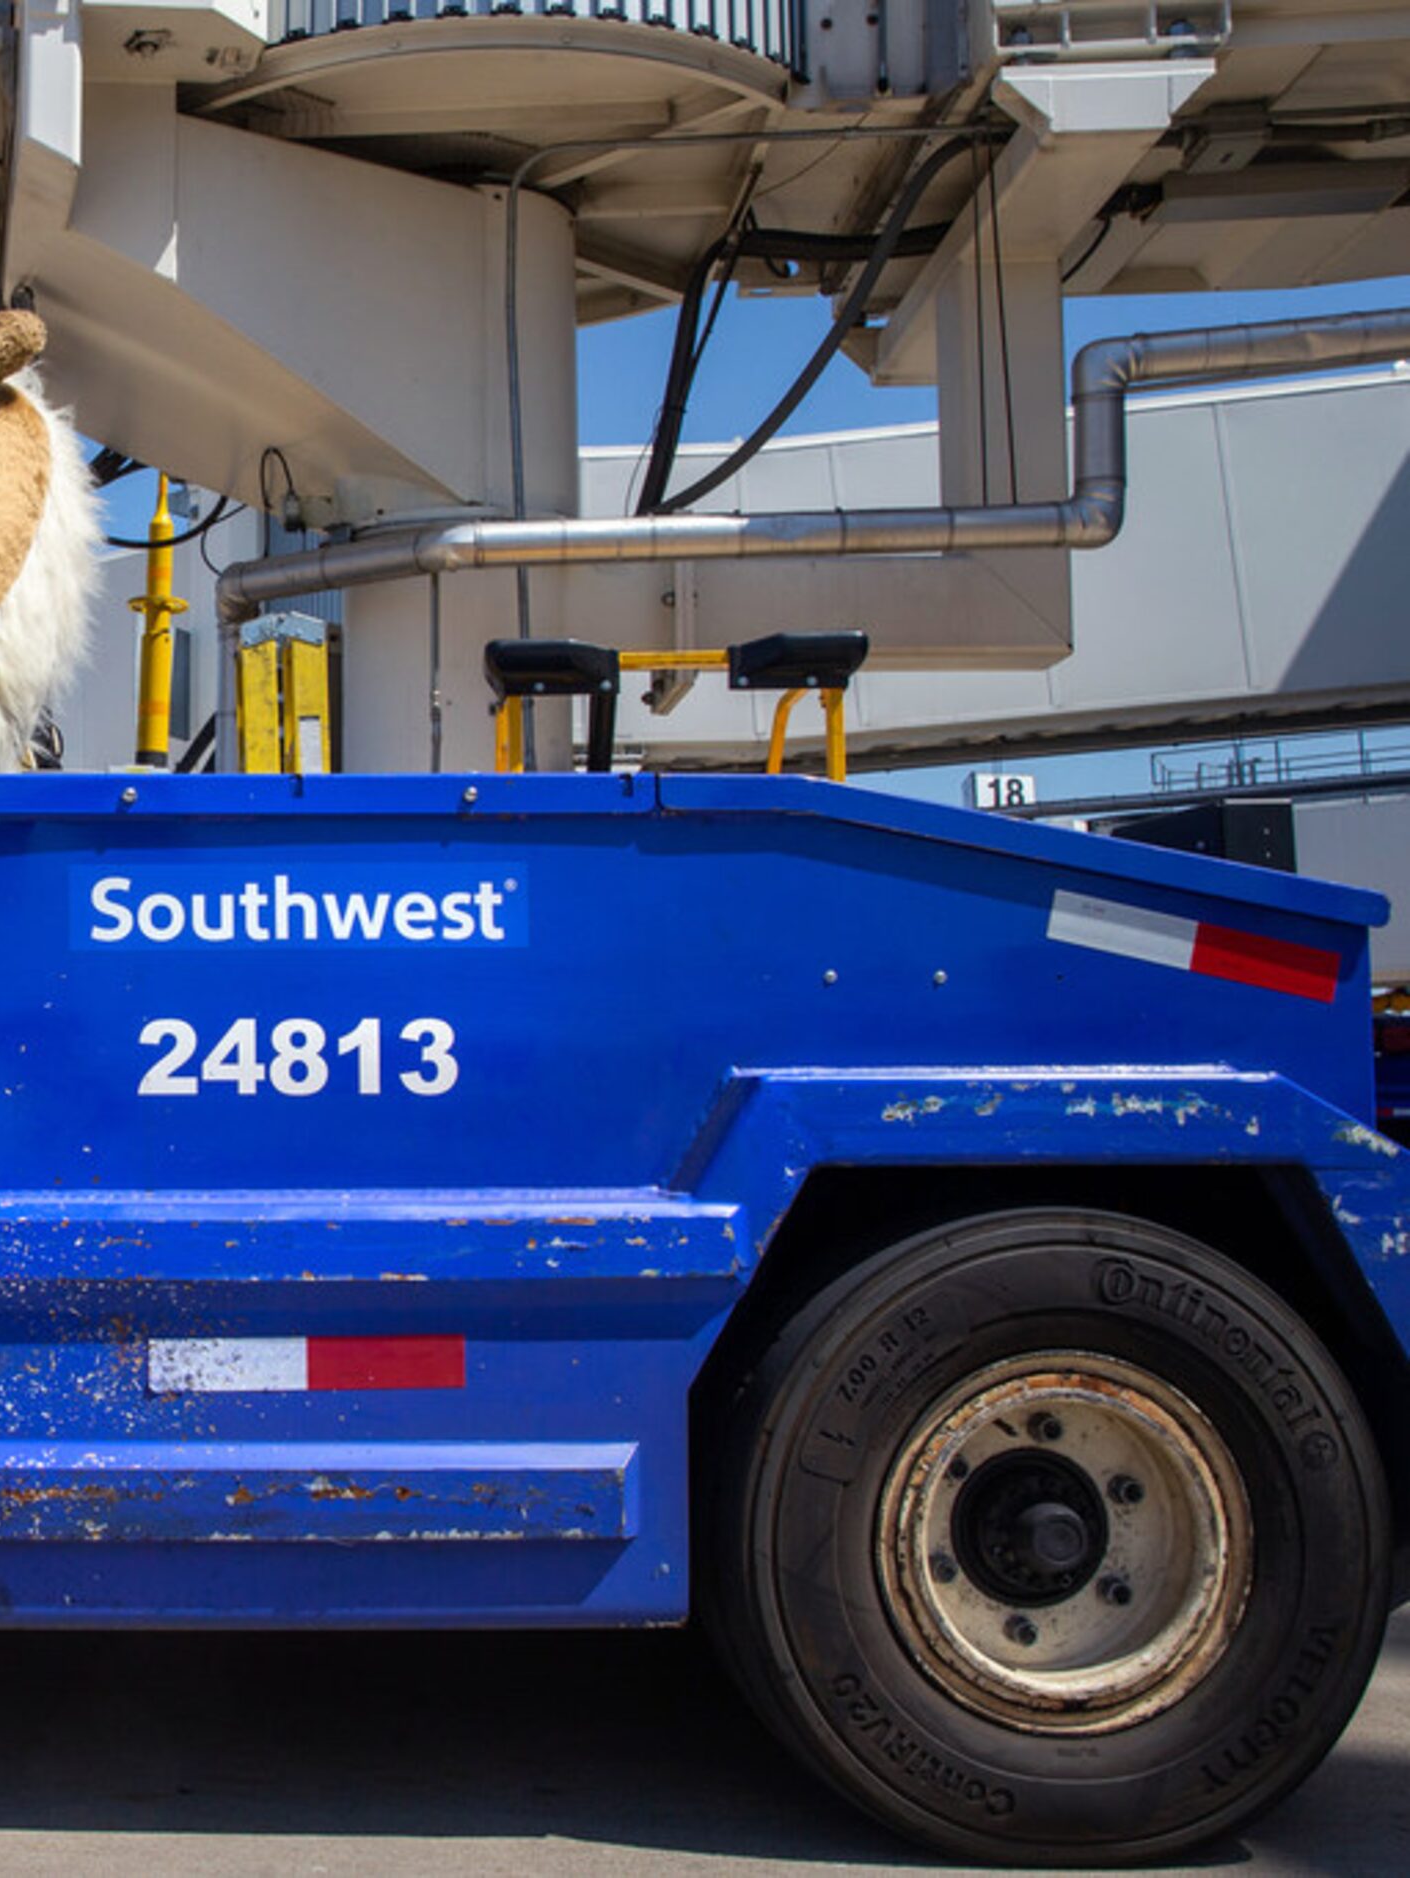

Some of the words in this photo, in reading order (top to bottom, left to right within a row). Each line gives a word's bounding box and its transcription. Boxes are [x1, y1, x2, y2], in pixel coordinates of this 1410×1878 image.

[988, 778, 1024, 807] 18
[90, 874, 506, 942] Southwest
[137, 1017, 460, 1096] 24813
[902, 1306, 930, 1332] 12
